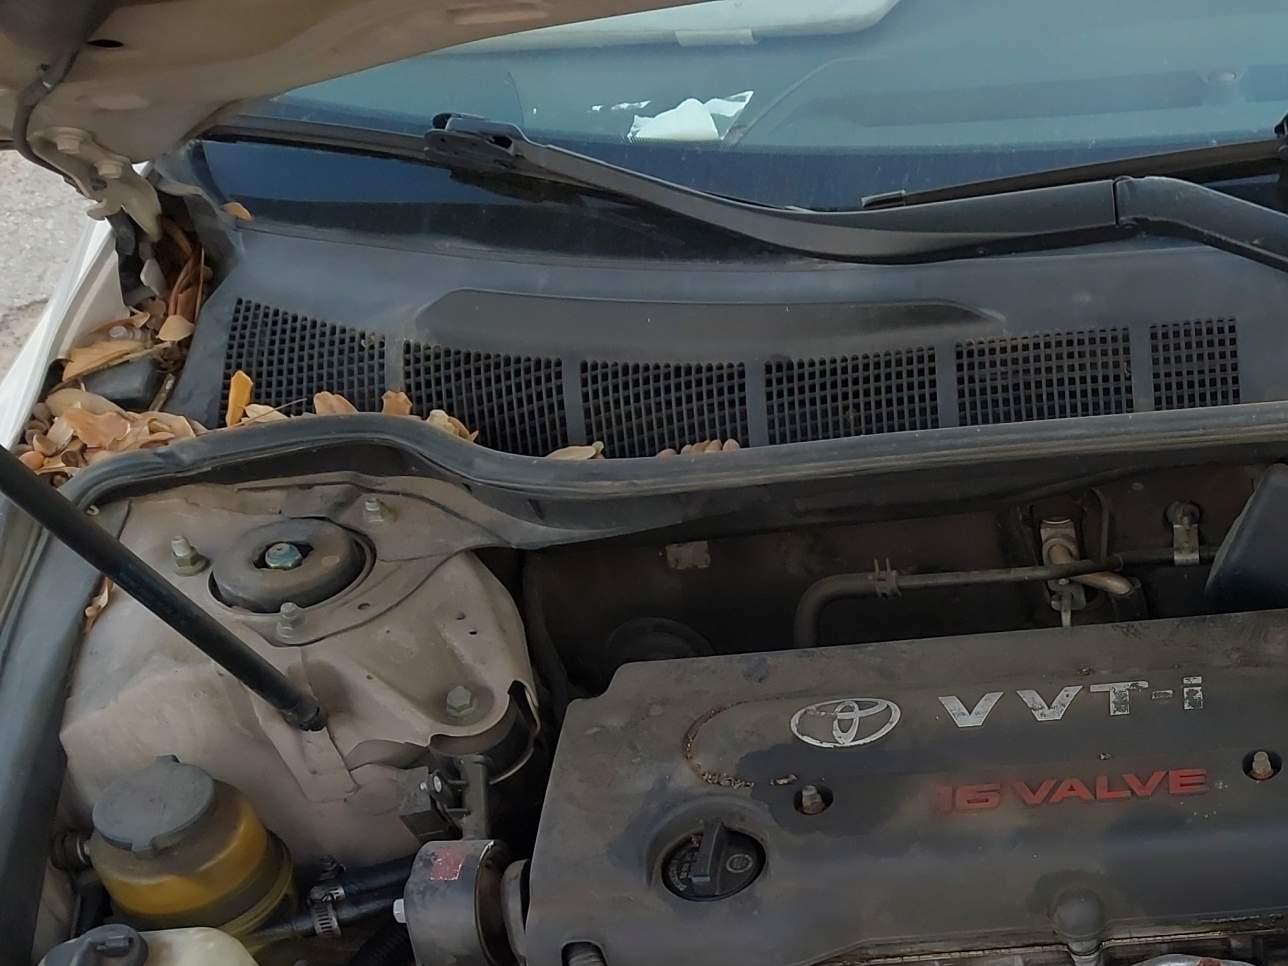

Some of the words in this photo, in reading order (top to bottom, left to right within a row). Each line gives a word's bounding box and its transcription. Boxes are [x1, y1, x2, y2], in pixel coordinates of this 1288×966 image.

[938, 675, 1203, 728] VVT-i
[935, 783, 1001, 812] 16
[1016, 769, 1210, 805] VALVE
